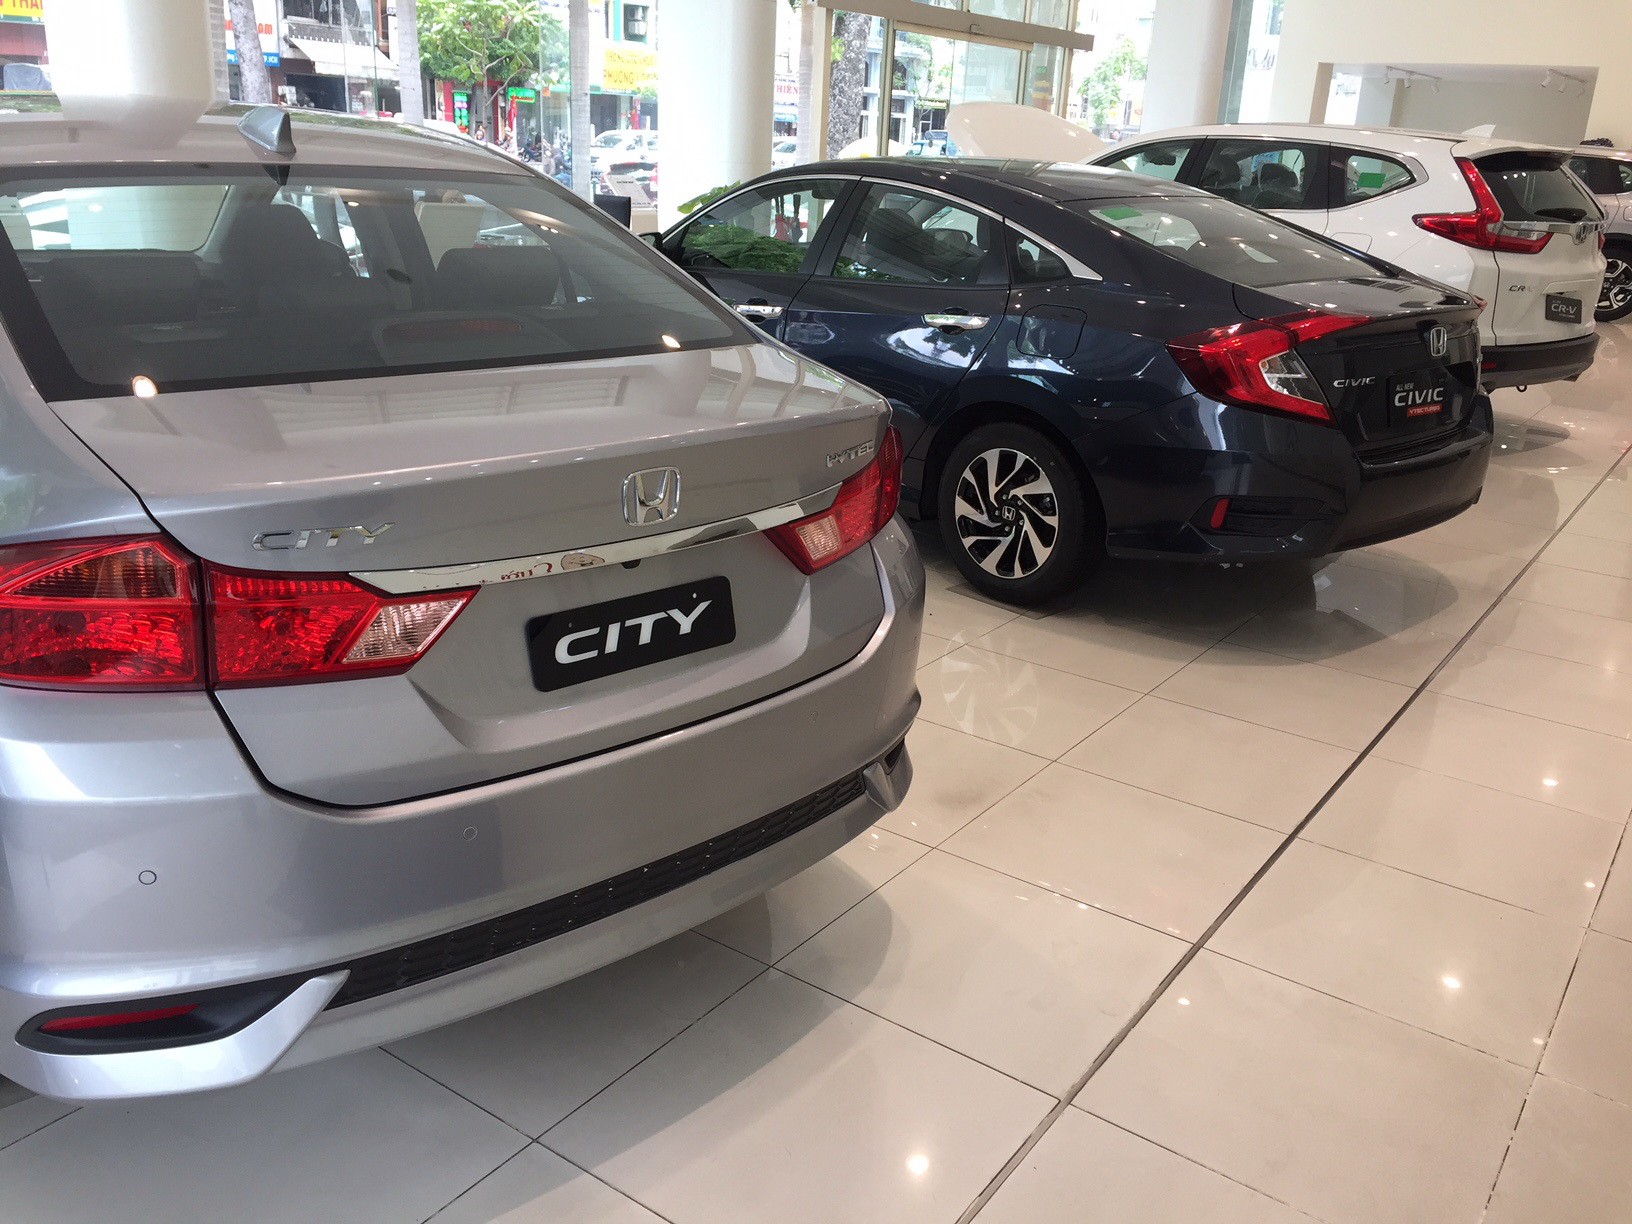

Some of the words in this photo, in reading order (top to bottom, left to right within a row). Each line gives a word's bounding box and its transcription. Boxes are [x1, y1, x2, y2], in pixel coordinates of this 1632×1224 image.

[1551, 304, 1577, 314] CR-V
[1333, 376, 1376, 388] CIVIC
[1394, 387, 1444, 407] CIVIC
[252, 522, 396, 551] CITY
[554, 599, 713, 665] CITY
